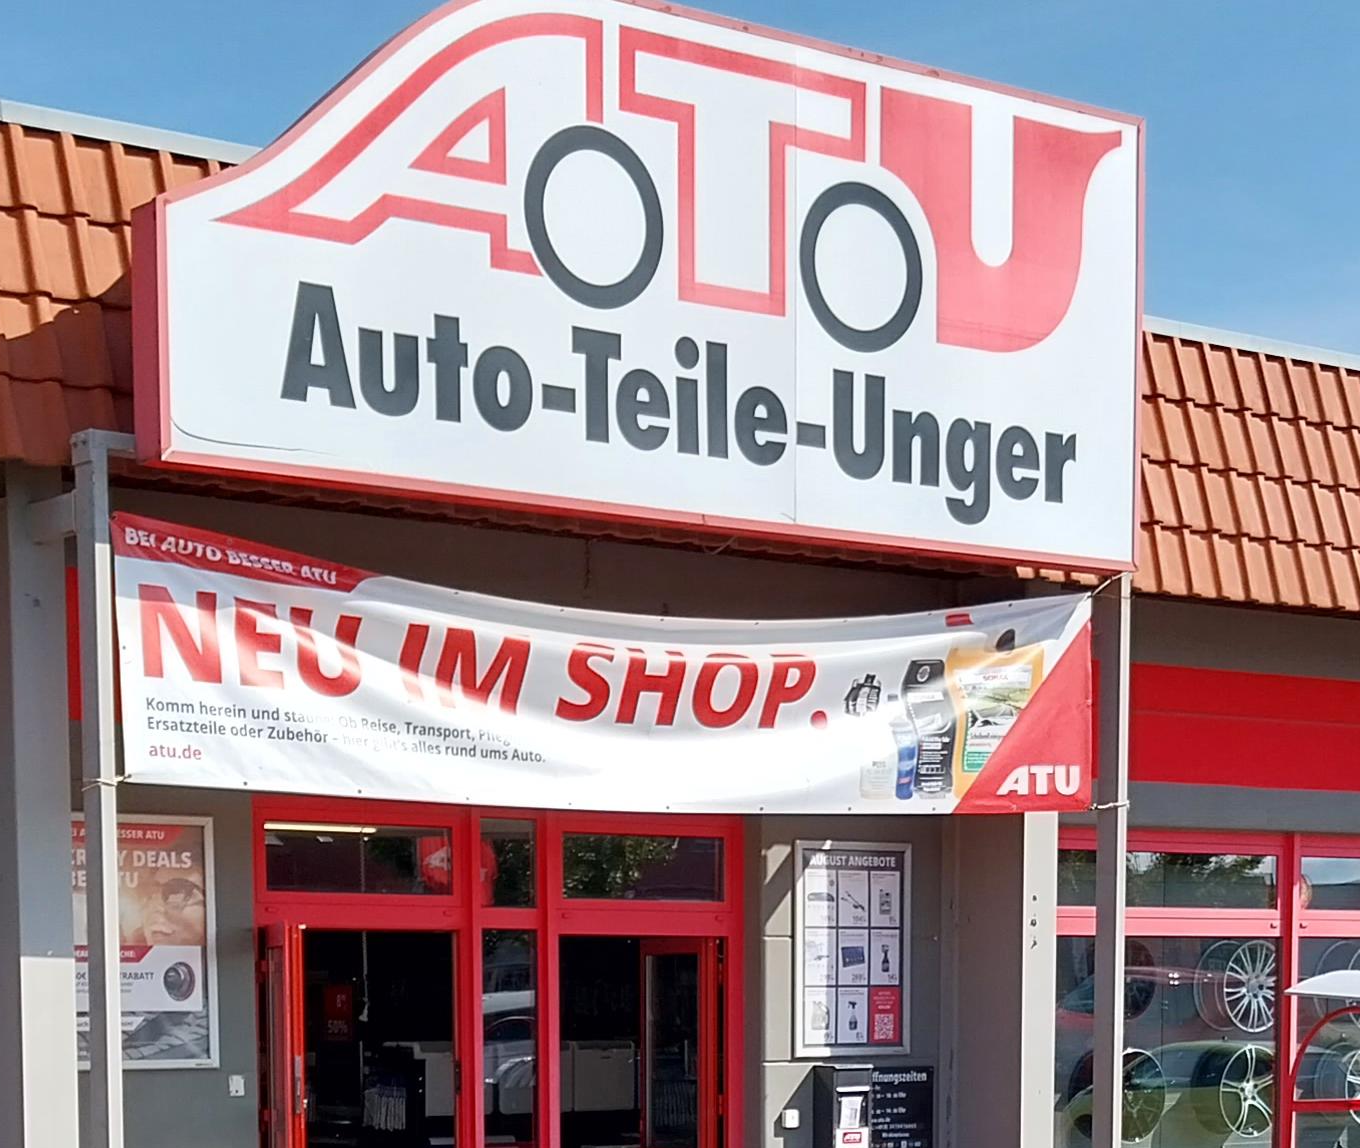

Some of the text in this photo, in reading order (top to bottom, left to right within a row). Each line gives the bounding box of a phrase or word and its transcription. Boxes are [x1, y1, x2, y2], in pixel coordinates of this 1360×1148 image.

[280, 281, 1077, 525] Auto-Teile-Unger
[161, 536, 222, 562] AUTO
[227, 550, 295, 576] BESSER
[300, 565, 337, 585] ATU
[137, 583, 828, 731] NEU IM SHOP.
[145, 697, 195, 715] Komm
[199, 701, 247, 719] herein
[251, 707, 280, 722] und
[404, 721, 476, 742] Transport,
[147, 716, 227, 737] Ersatzteile
[230, 723, 264, 739] oder
[267, 725, 328, 744] Zubehör
[411, 740, 442, 756] alles
[444, 744, 477, 758] rund
[480, 747, 508, 761] ums
[511, 748, 546, 764] Auto.
[148, 744, 203, 761] atu.de
[995, 764, 1082, 796] ATU
[117, 828, 165, 840] ESSER ATU
[133, 850, 192, 869] DEALS
[809, 855, 896, 868] AUGUST ANGEBOTE
[871, 1070, 928, 1085] ffnungszeiten
